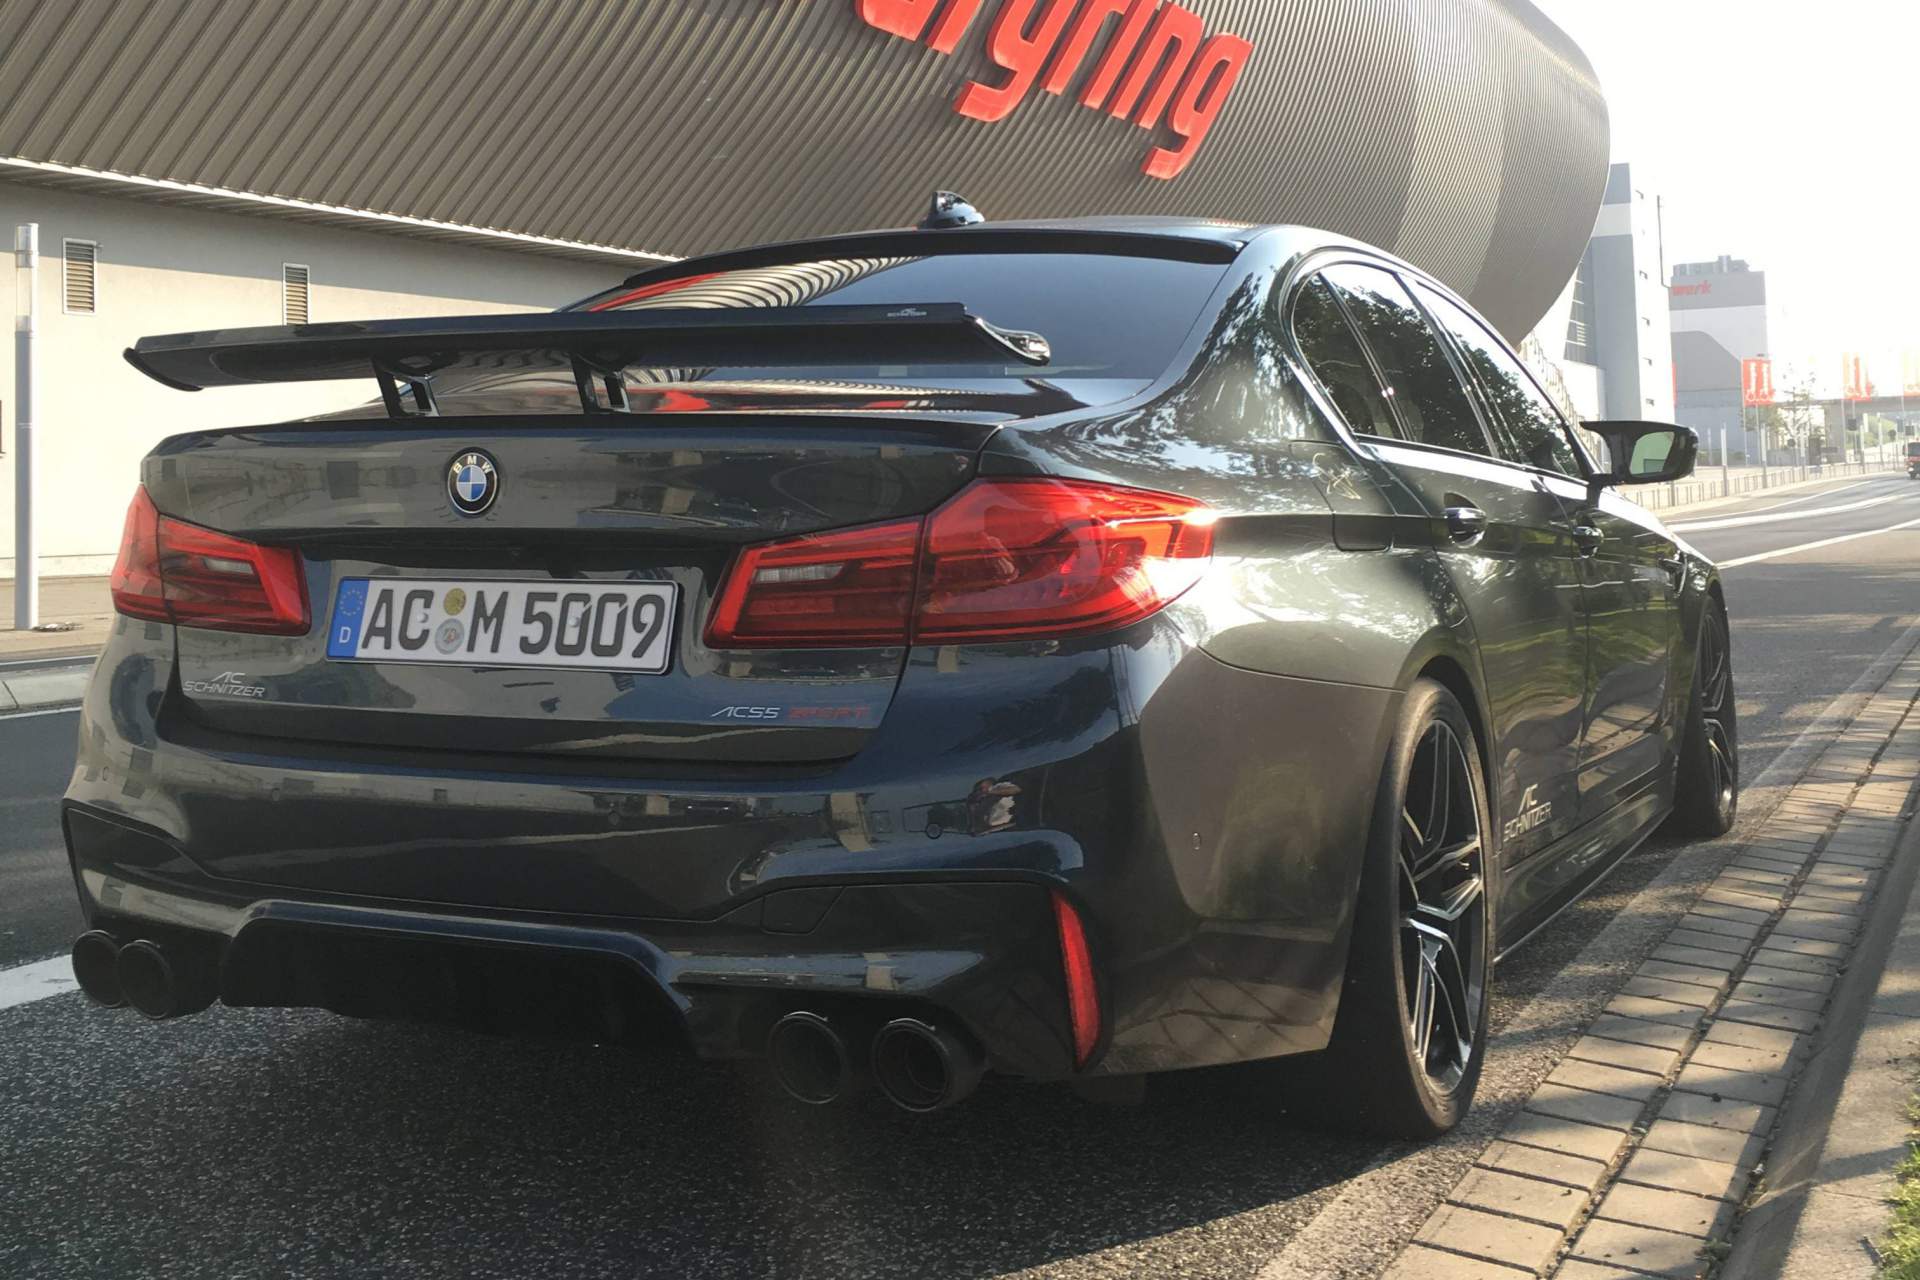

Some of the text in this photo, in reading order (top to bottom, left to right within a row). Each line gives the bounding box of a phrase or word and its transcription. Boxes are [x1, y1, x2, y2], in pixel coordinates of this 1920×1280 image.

[361, 589, 435, 651] AC
[519, 592, 667, 658] 5009
[339, 627, 351, 644] D
[211, 671, 246, 684] AC
[183, 680, 266, 698] SCHNITZER
[1503, 801, 1552, 842] SCHNITZER
